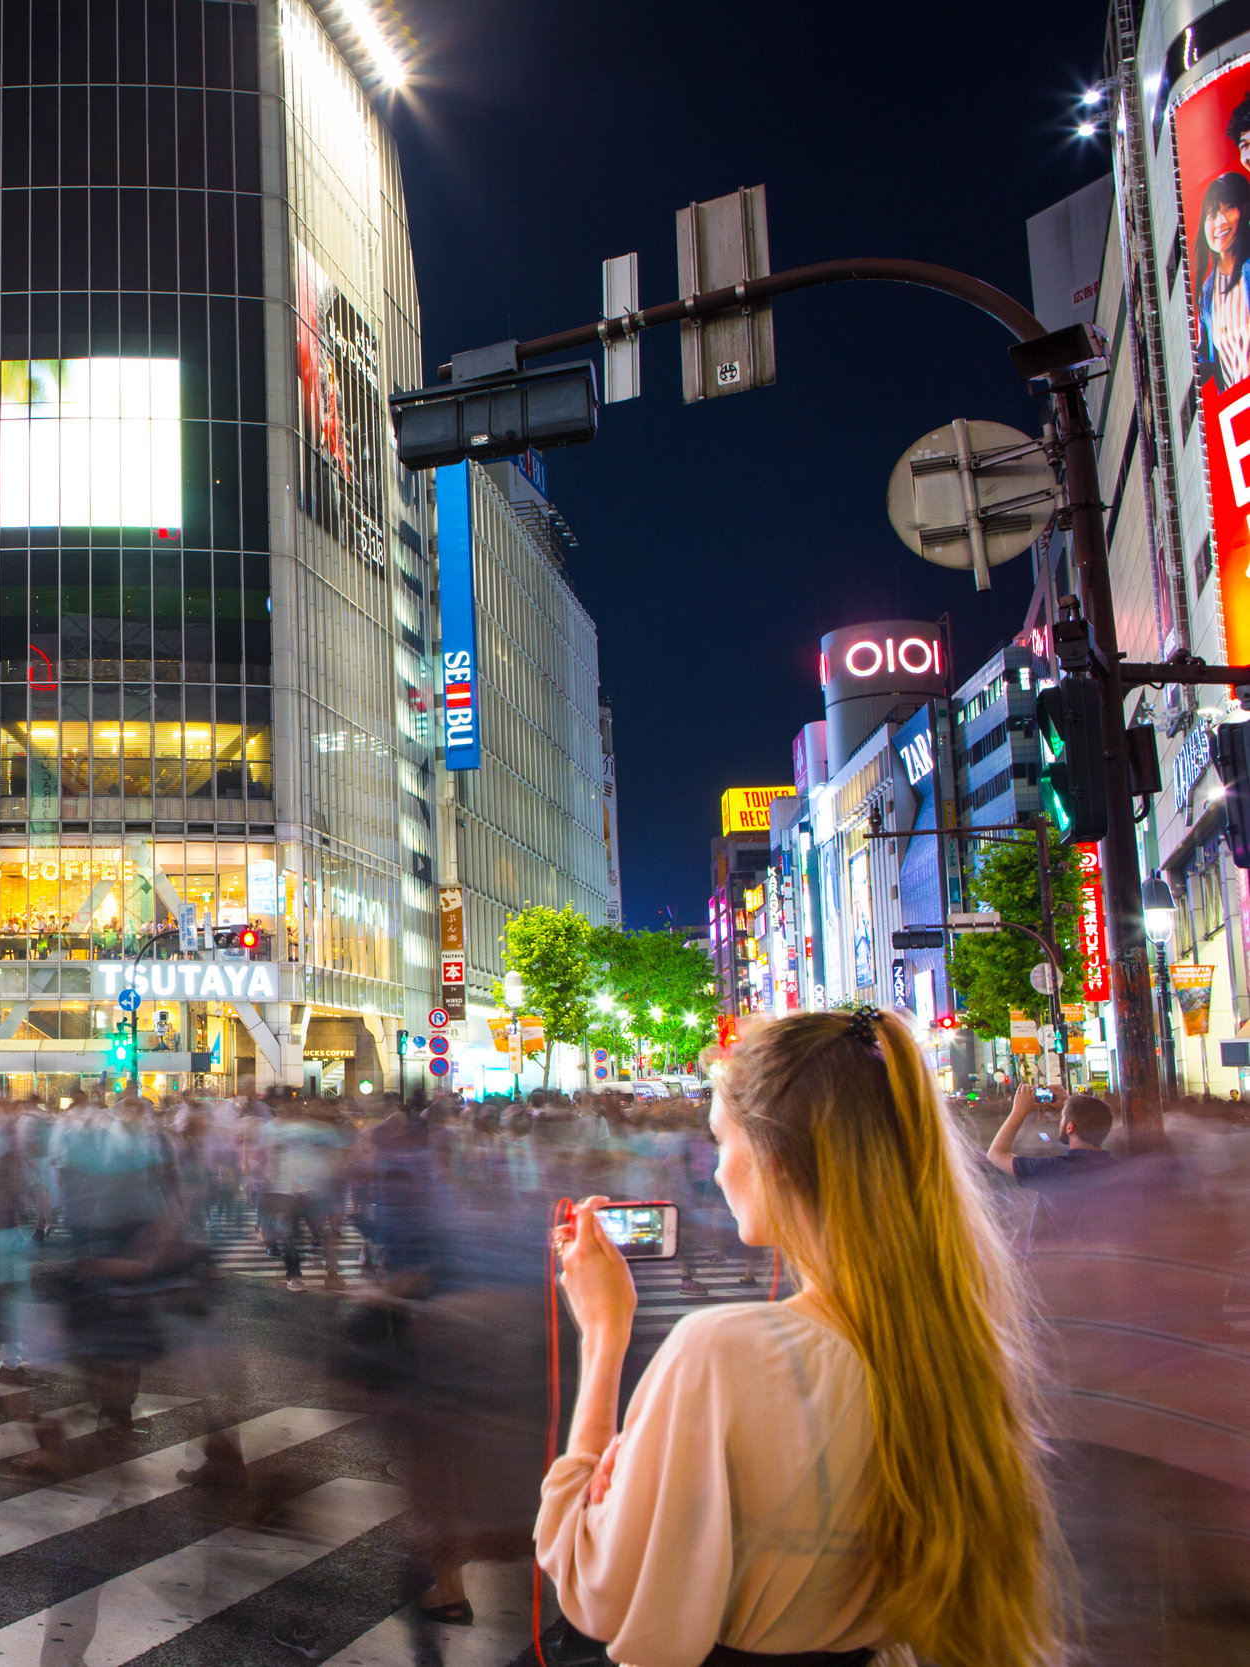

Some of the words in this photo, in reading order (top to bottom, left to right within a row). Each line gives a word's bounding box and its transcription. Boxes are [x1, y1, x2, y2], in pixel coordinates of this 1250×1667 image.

[900, 728, 934, 786] ZAR
[22, 859, 134, 881] COFFEE
[767, 865, 780, 928] KARAOKE
[98, 964, 274, 996] TSUTAYA
[445, 963, 461, 980] 本
